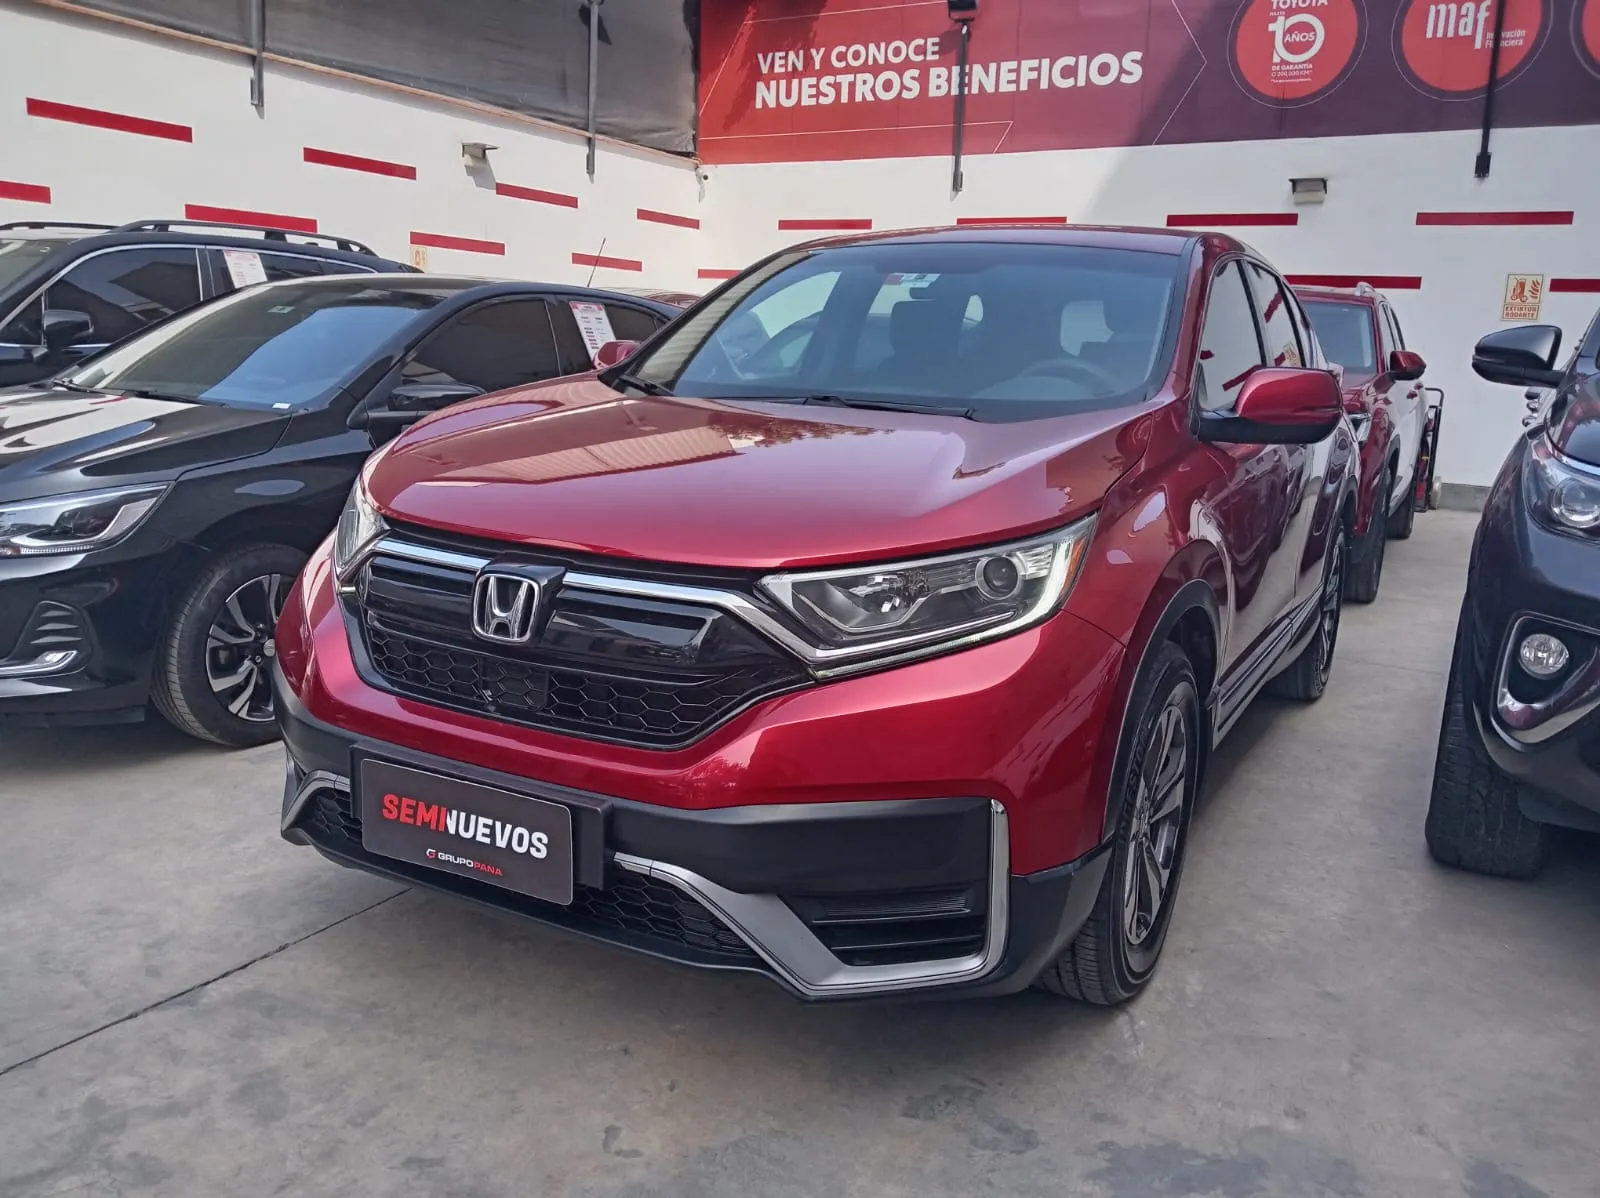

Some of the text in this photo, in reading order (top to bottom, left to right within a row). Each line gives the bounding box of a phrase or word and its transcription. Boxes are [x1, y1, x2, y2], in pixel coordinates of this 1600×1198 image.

[1284, 31, 1315, 42] AÑOS
[1426, 0, 1492, 49] maf
[755, 51, 1143, 108] NUESTROS BENEFICIOS
[757, 37, 940, 74] VEN Y CONOCE
[382, 794, 548, 859] SEMINUEVOS
